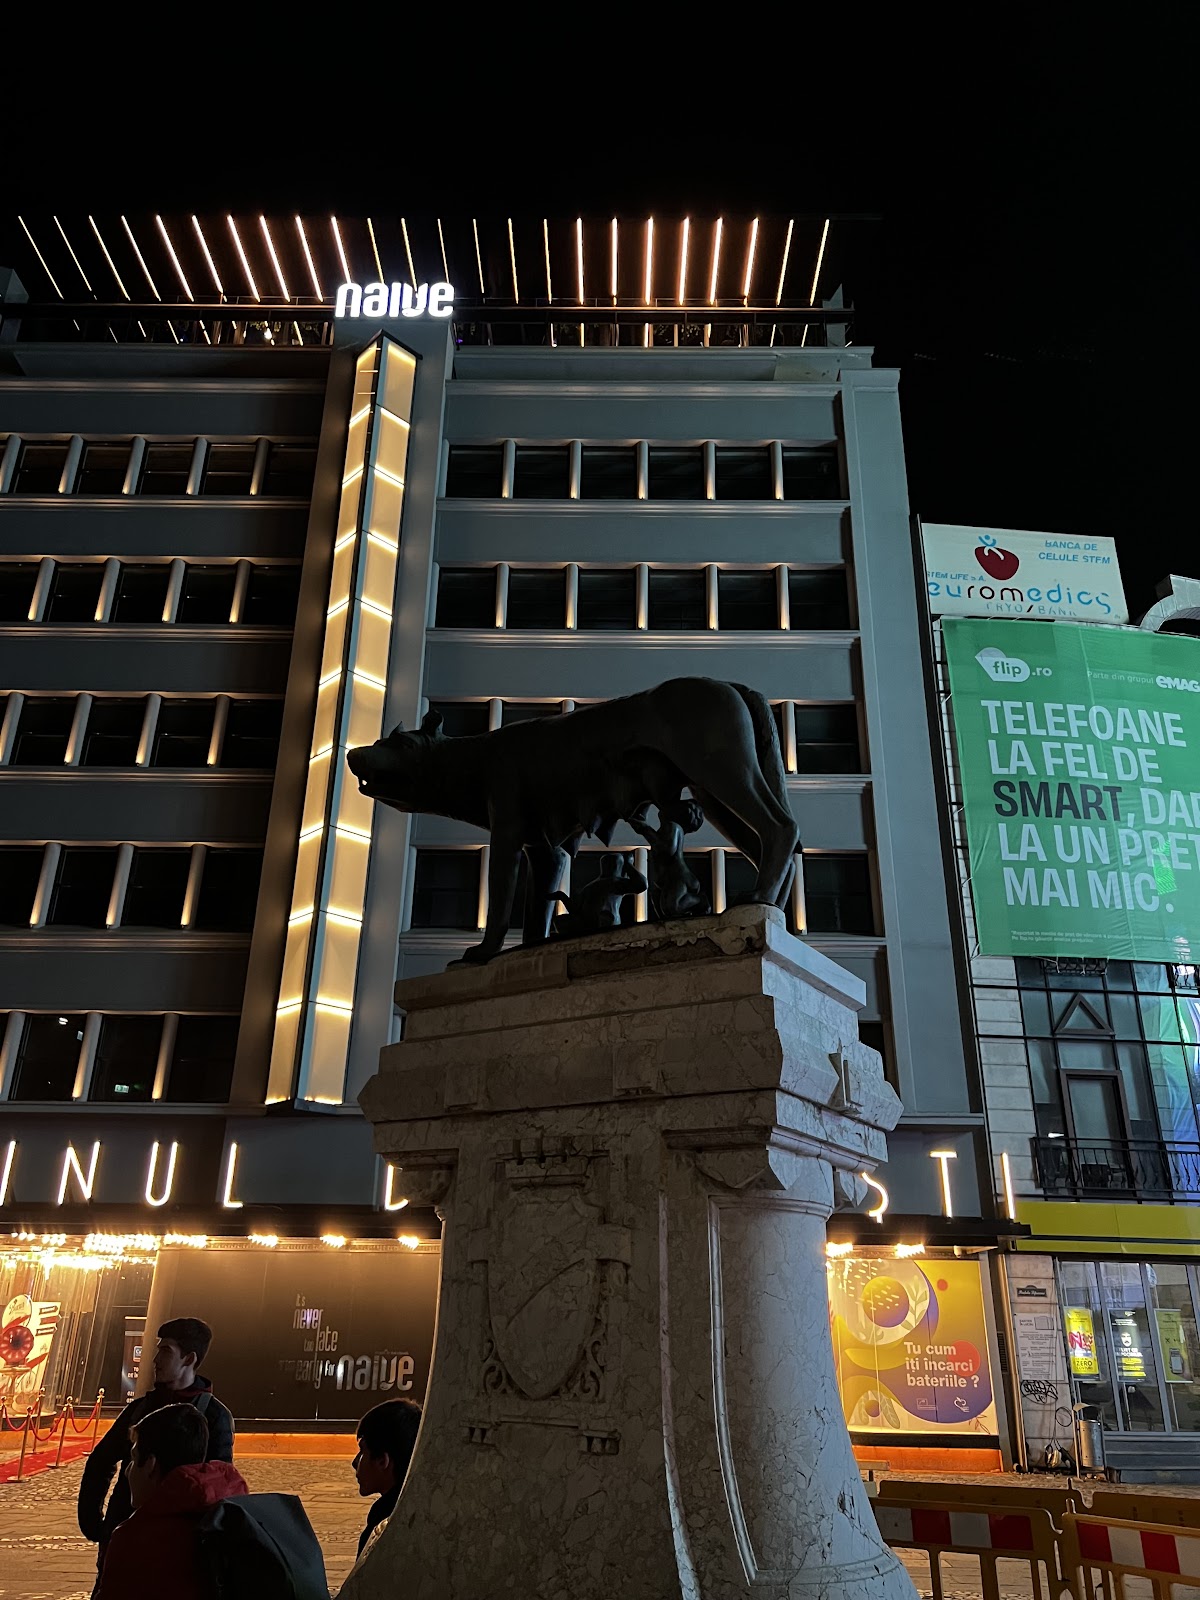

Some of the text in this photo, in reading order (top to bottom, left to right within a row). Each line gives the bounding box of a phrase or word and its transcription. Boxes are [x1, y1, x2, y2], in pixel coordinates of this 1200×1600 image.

[1044, 539, 1098, 551] BANCA DE
[1038, 552, 1111, 564] CELULE STEM
[950, 573, 969, 581] LIFE
[928, 581, 1111, 615] euromedics
[1127, 675, 1154, 685] grupul
[980, 700, 1187, 748] TELEFOANE
[987, 739, 1163, 784] LA FEL DE
[998, 822, 1047, 862] LA
[1053, 824, 1110, 865] UN
[1003, 866, 1175, 914] MAI MIC.
[292, 1308, 324, 1330] never
[315, 1325, 339, 1352] late
[903, 1341, 957, 1356] Tu cum
[923, 1357, 974, 1372] încarci
[906, 1373, 968, 1388] bateriile
